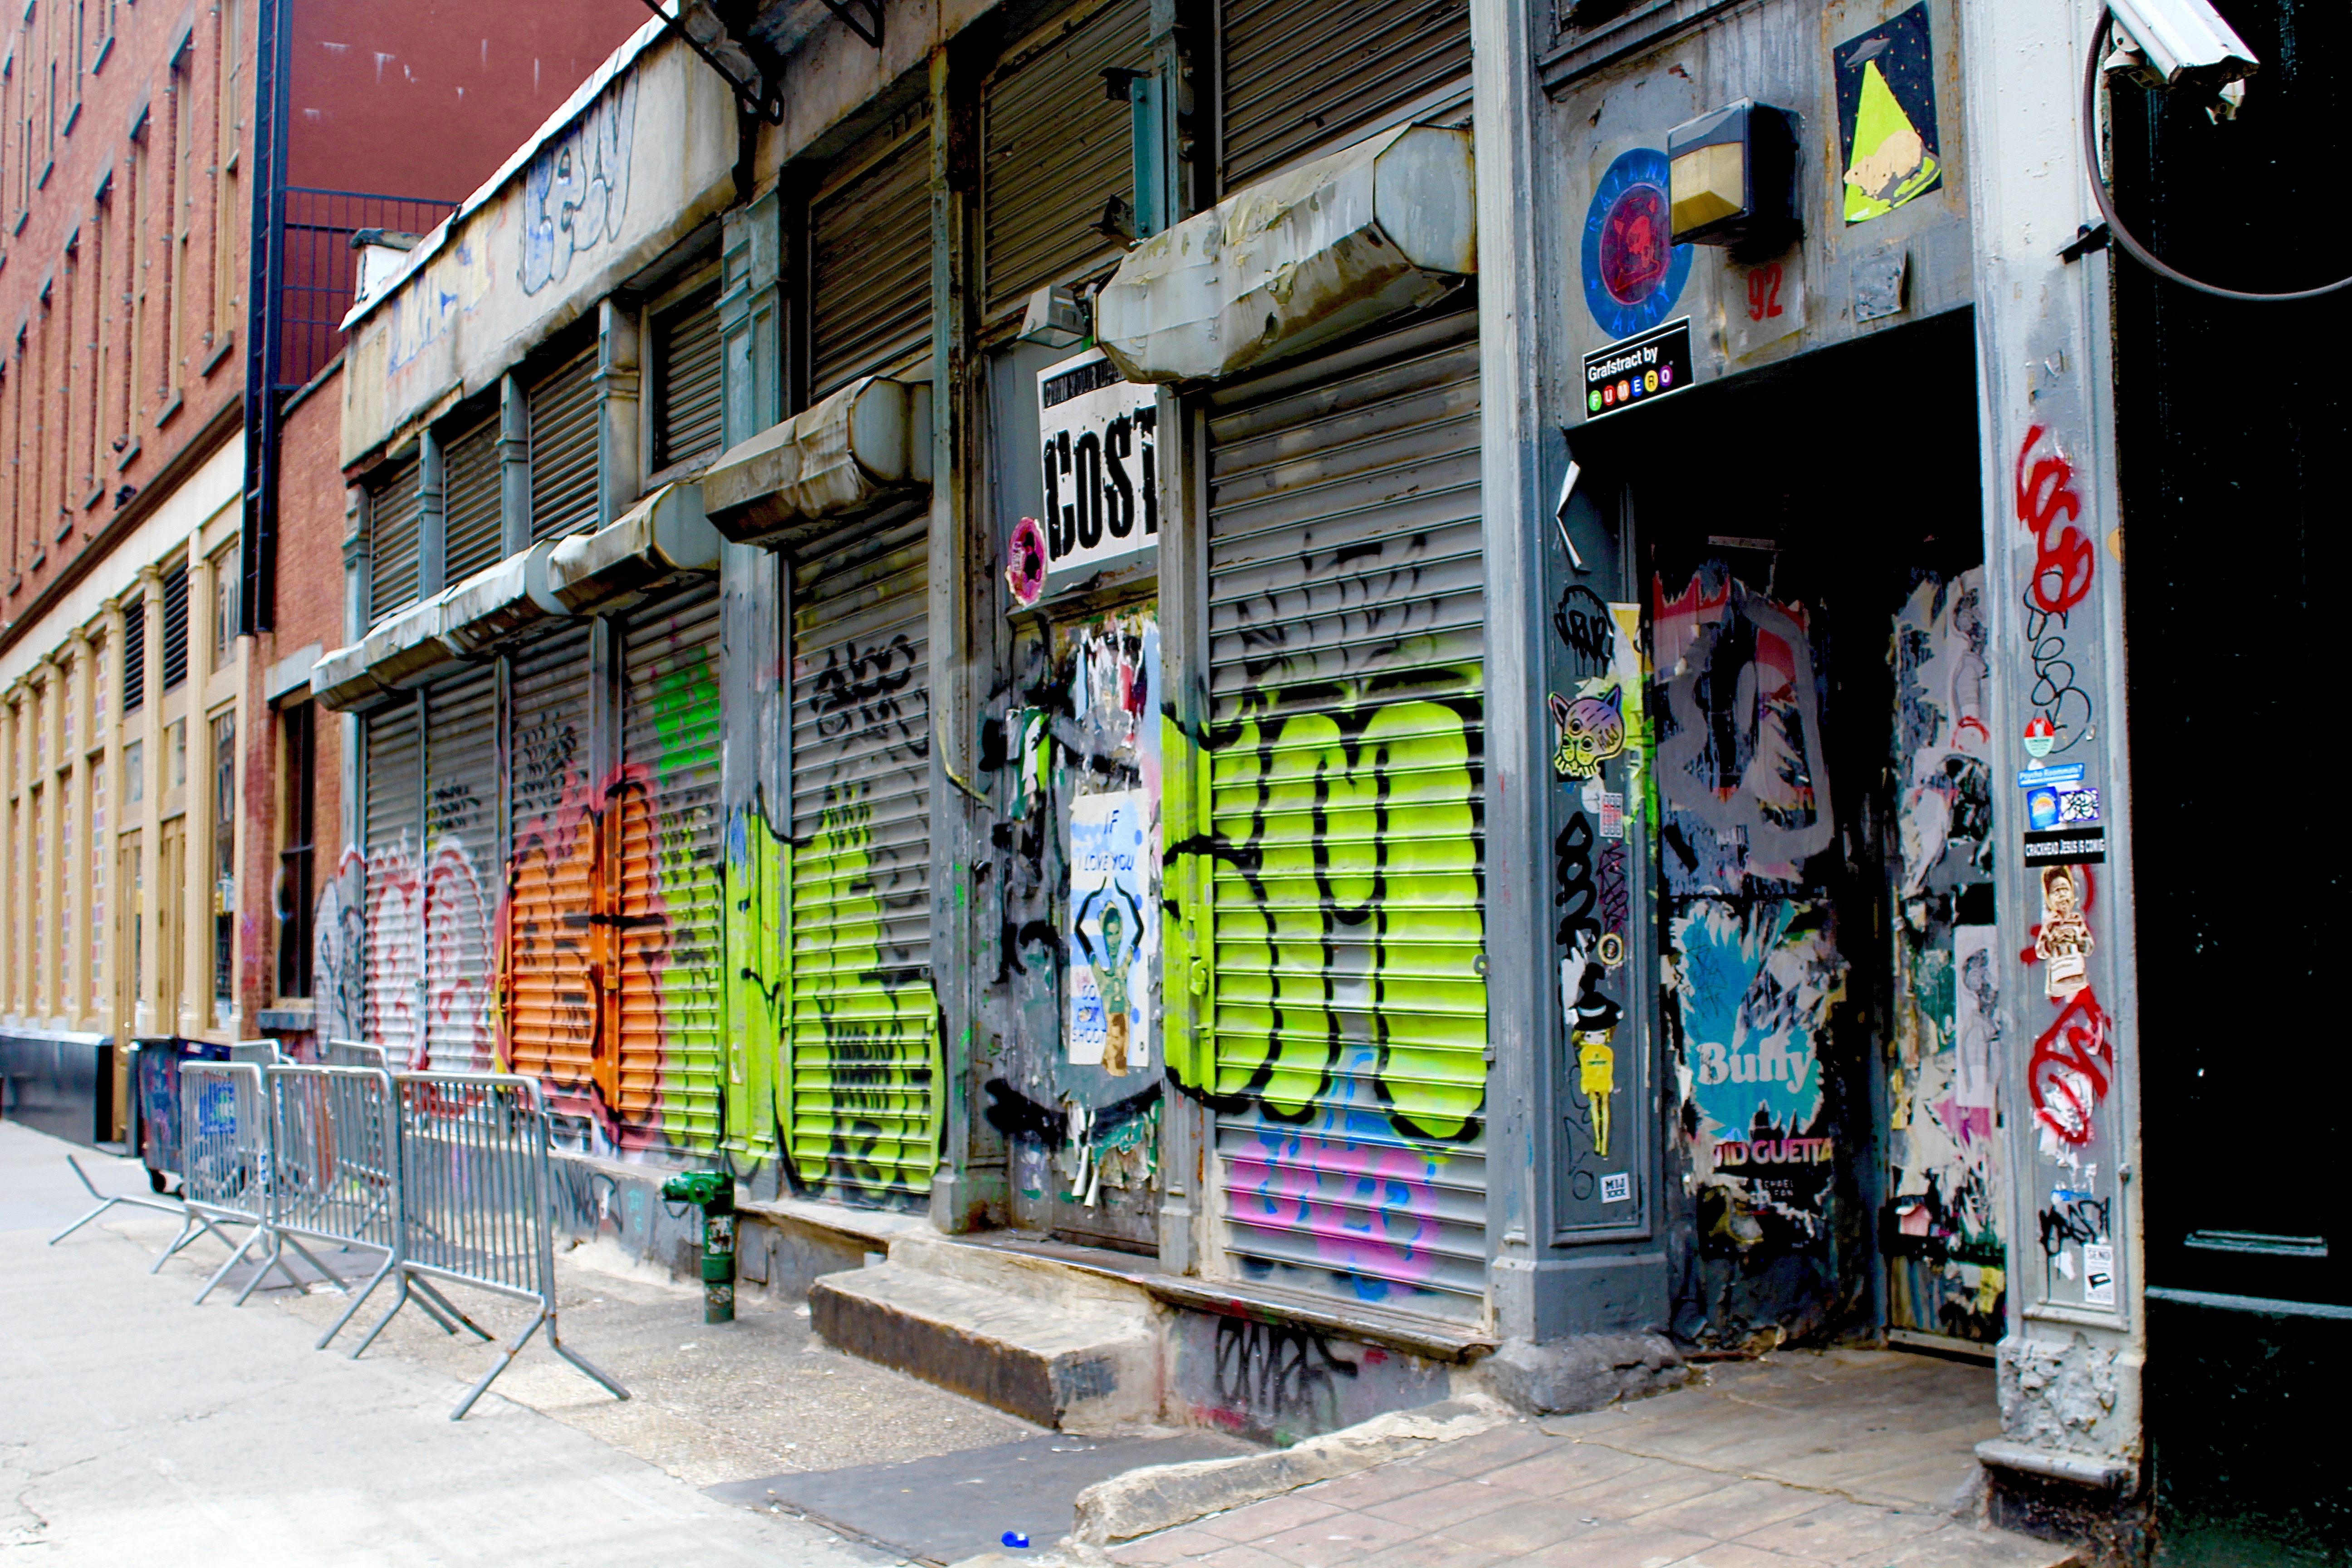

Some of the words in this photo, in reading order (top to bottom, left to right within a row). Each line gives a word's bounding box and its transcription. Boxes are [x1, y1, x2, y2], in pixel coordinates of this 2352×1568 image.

[1748, 263, 1783, 322] 92
[1588, 351, 1643, 382] Grafstract
[1642, 346, 1659, 364] by
[1590, 367, 1672, 409] FUMERO
[1044, 404, 1157, 562] COST
[1103, 809, 1119, 834] IF
[1084, 854, 1108, 871] LOVE
[1112, 853, 1135, 871] YOU
[1696, 1037, 1814, 1094] Buffy
[1751, 1137, 1833, 1166] GUETTA
